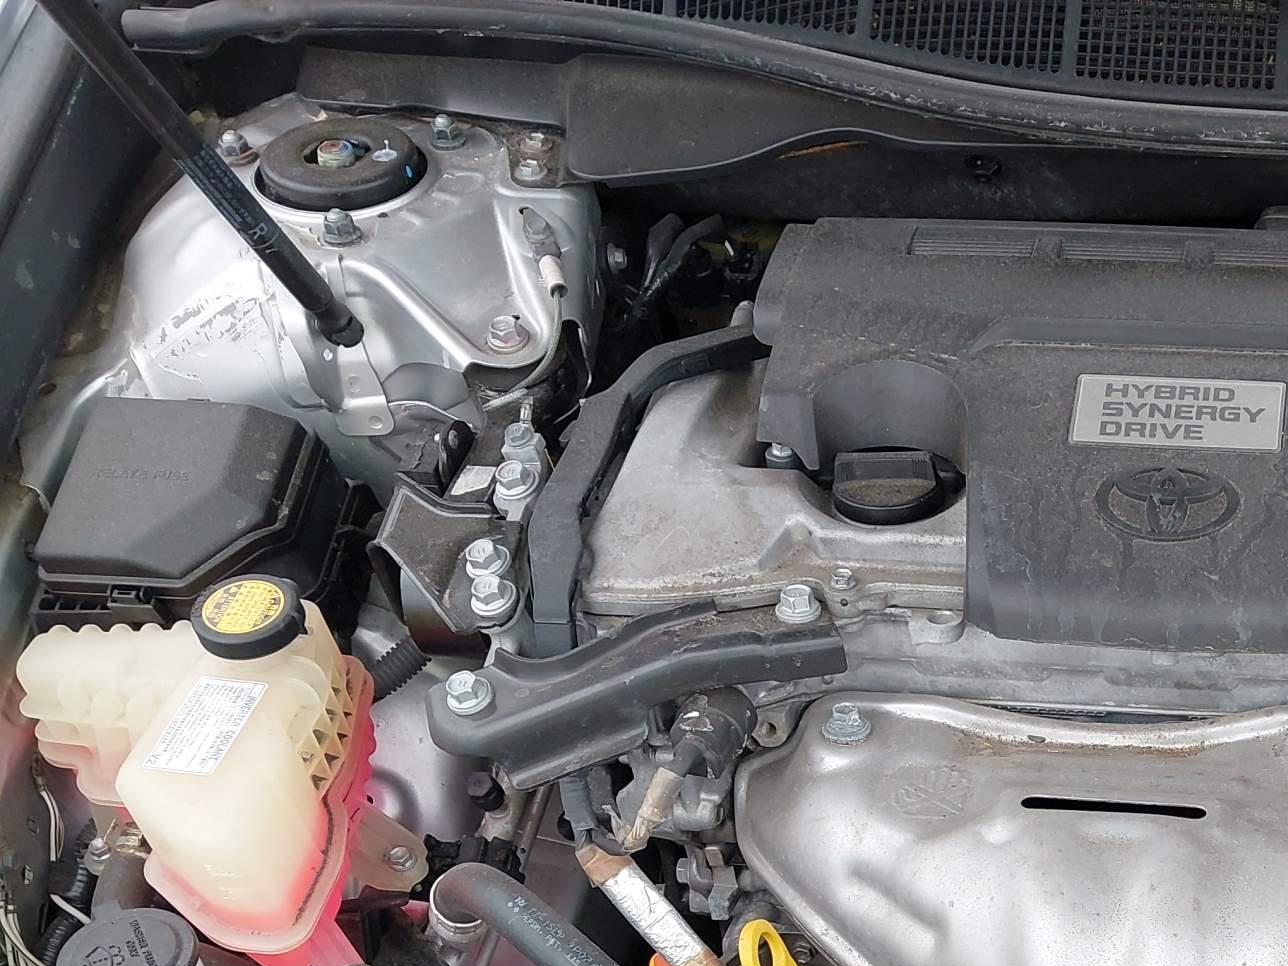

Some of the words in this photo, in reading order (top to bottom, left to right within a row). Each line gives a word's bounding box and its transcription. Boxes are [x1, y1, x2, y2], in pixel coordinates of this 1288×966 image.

[1105, 383, 1235, 402] HYBRID
[1102, 401, 1266, 423] SYNERGY
[1099, 420, 1204, 440] DRIVE
